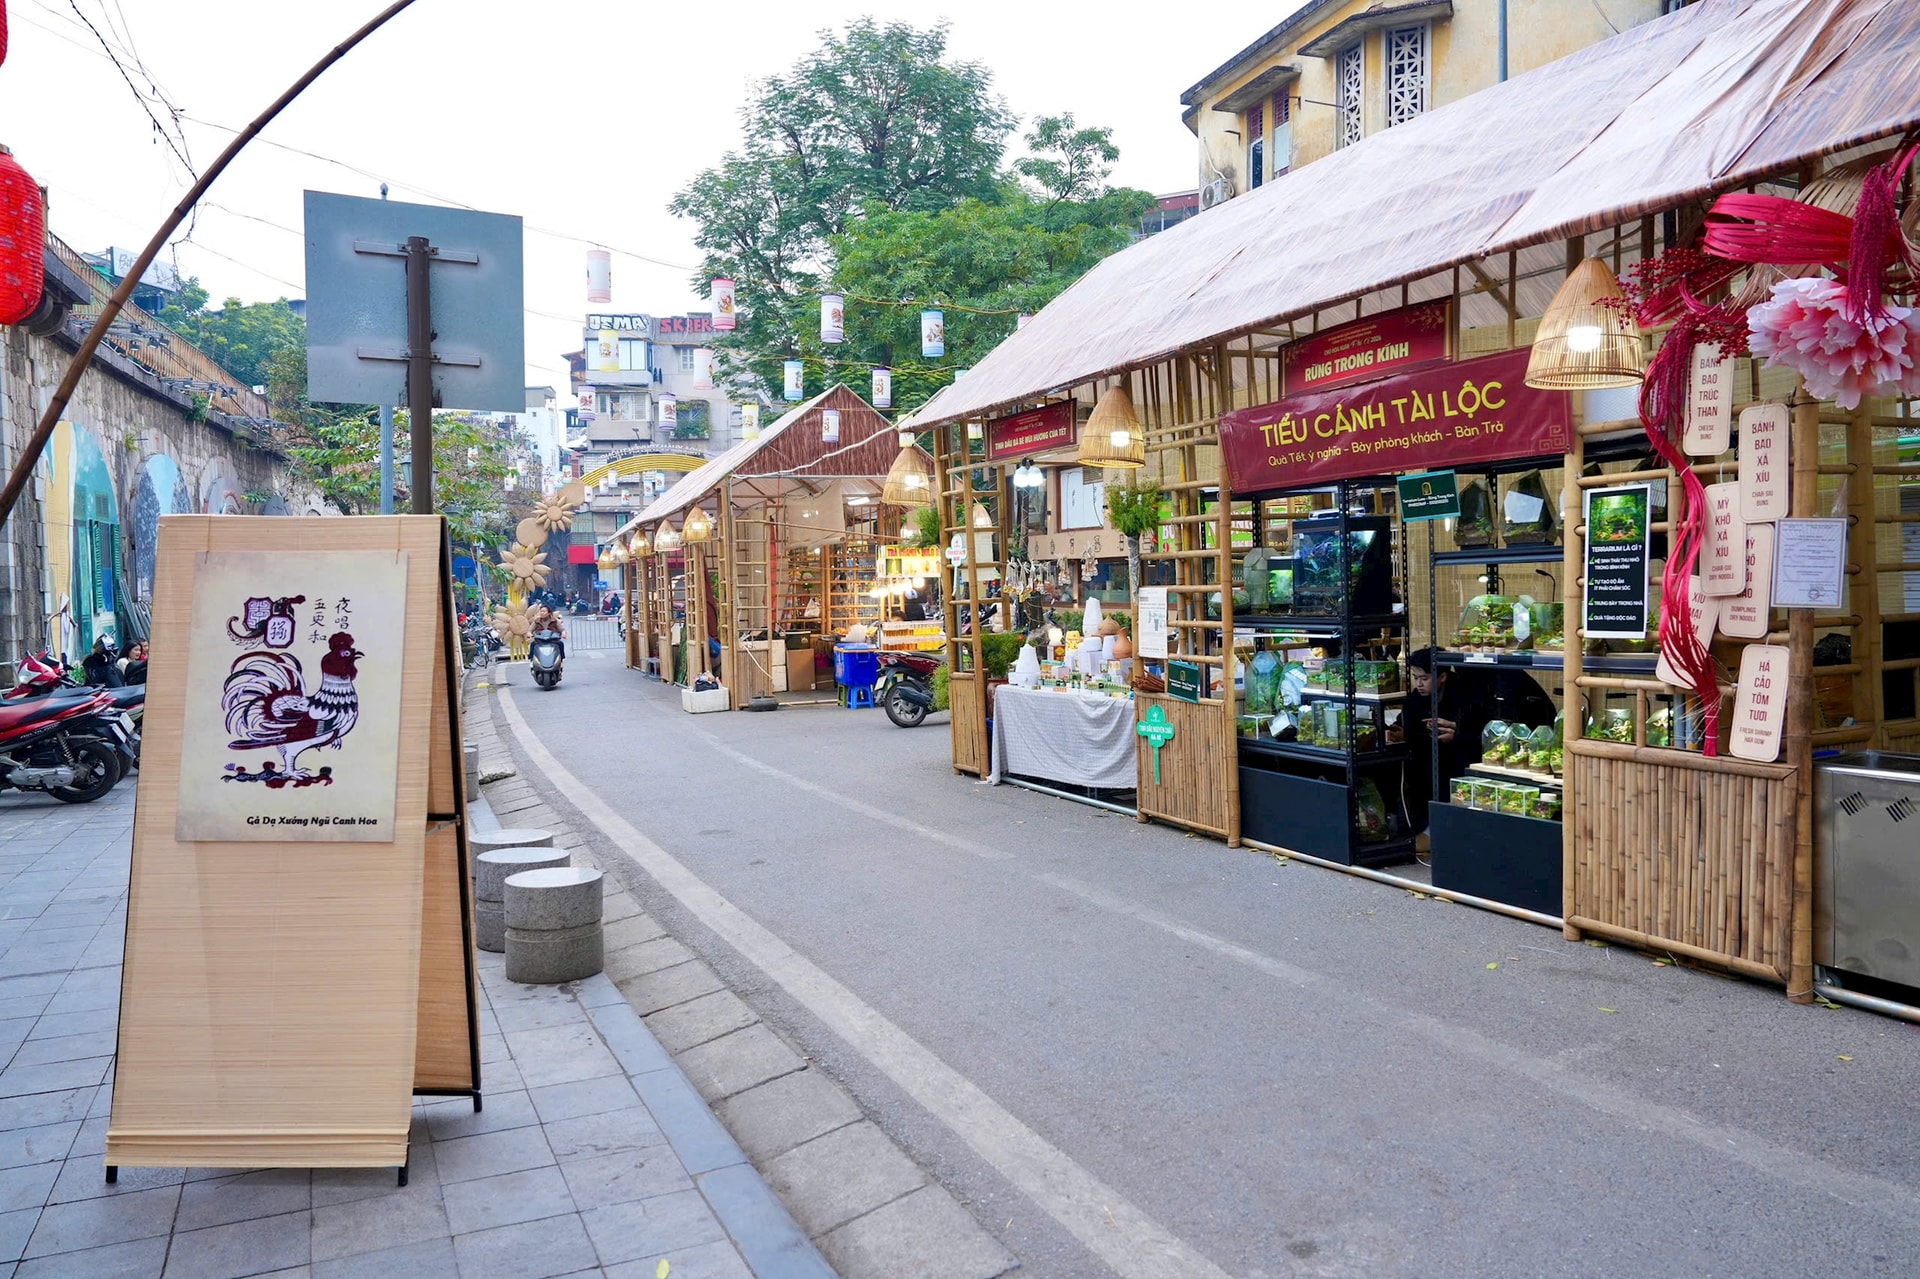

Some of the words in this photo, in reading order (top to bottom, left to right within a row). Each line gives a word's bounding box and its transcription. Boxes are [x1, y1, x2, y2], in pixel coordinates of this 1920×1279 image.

[1334, 350, 1374, 373] TRONG
[1377, 342, 1409, 363] KÍNH
[1702, 374, 1717, 384] BAO
[1699, 389, 1718, 400] TRÚC
[1259, 412, 1308, 448] TIỂU
[1314, 402, 1386, 438] CẢNH
[1391, 390, 1436, 424] TÀI
[1442, 380, 1506, 419] LỘC
[1697, 407, 1718, 417] THAN
[1752, 421, 1774, 434] BÁNH
[1268, 456, 1287, 466] Quà
[1288, 452, 1306, 463] Tết
[1317, 445, 1342, 461] nghĩa
[1352, 441, 1372, 454] Bày
[1374, 433, 1410, 453] phòng
[1410, 429, 1443, 445] khách
[1455, 426, 1479, 438] Bàn
[1482, 421, 1504, 434] Trà
[1755, 439, 1771, 450] BAO
[1757, 454, 1769, 466] XÁ
[1756, 471, 1770, 483] XÍU
[1715, 513, 1730, 526] KHÔ
[1717, 529, 1728, 541] XÁ
[1716, 545, 1728, 557] XÍU
[1759, 660, 1770, 672] HÁ
[1754, 676, 1770, 688] CẢO
[1752, 692, 1769, 705] TÔM
[247, 816, 259, 825] Gà
[262, 817, 276, 827] Dạ
[278, 816, 308, 826] Xướng
[311, 817, 330, 826] Ngũ
[332, 817, 356, 825] Canh
[358, 817, 377, 825] Hoa
